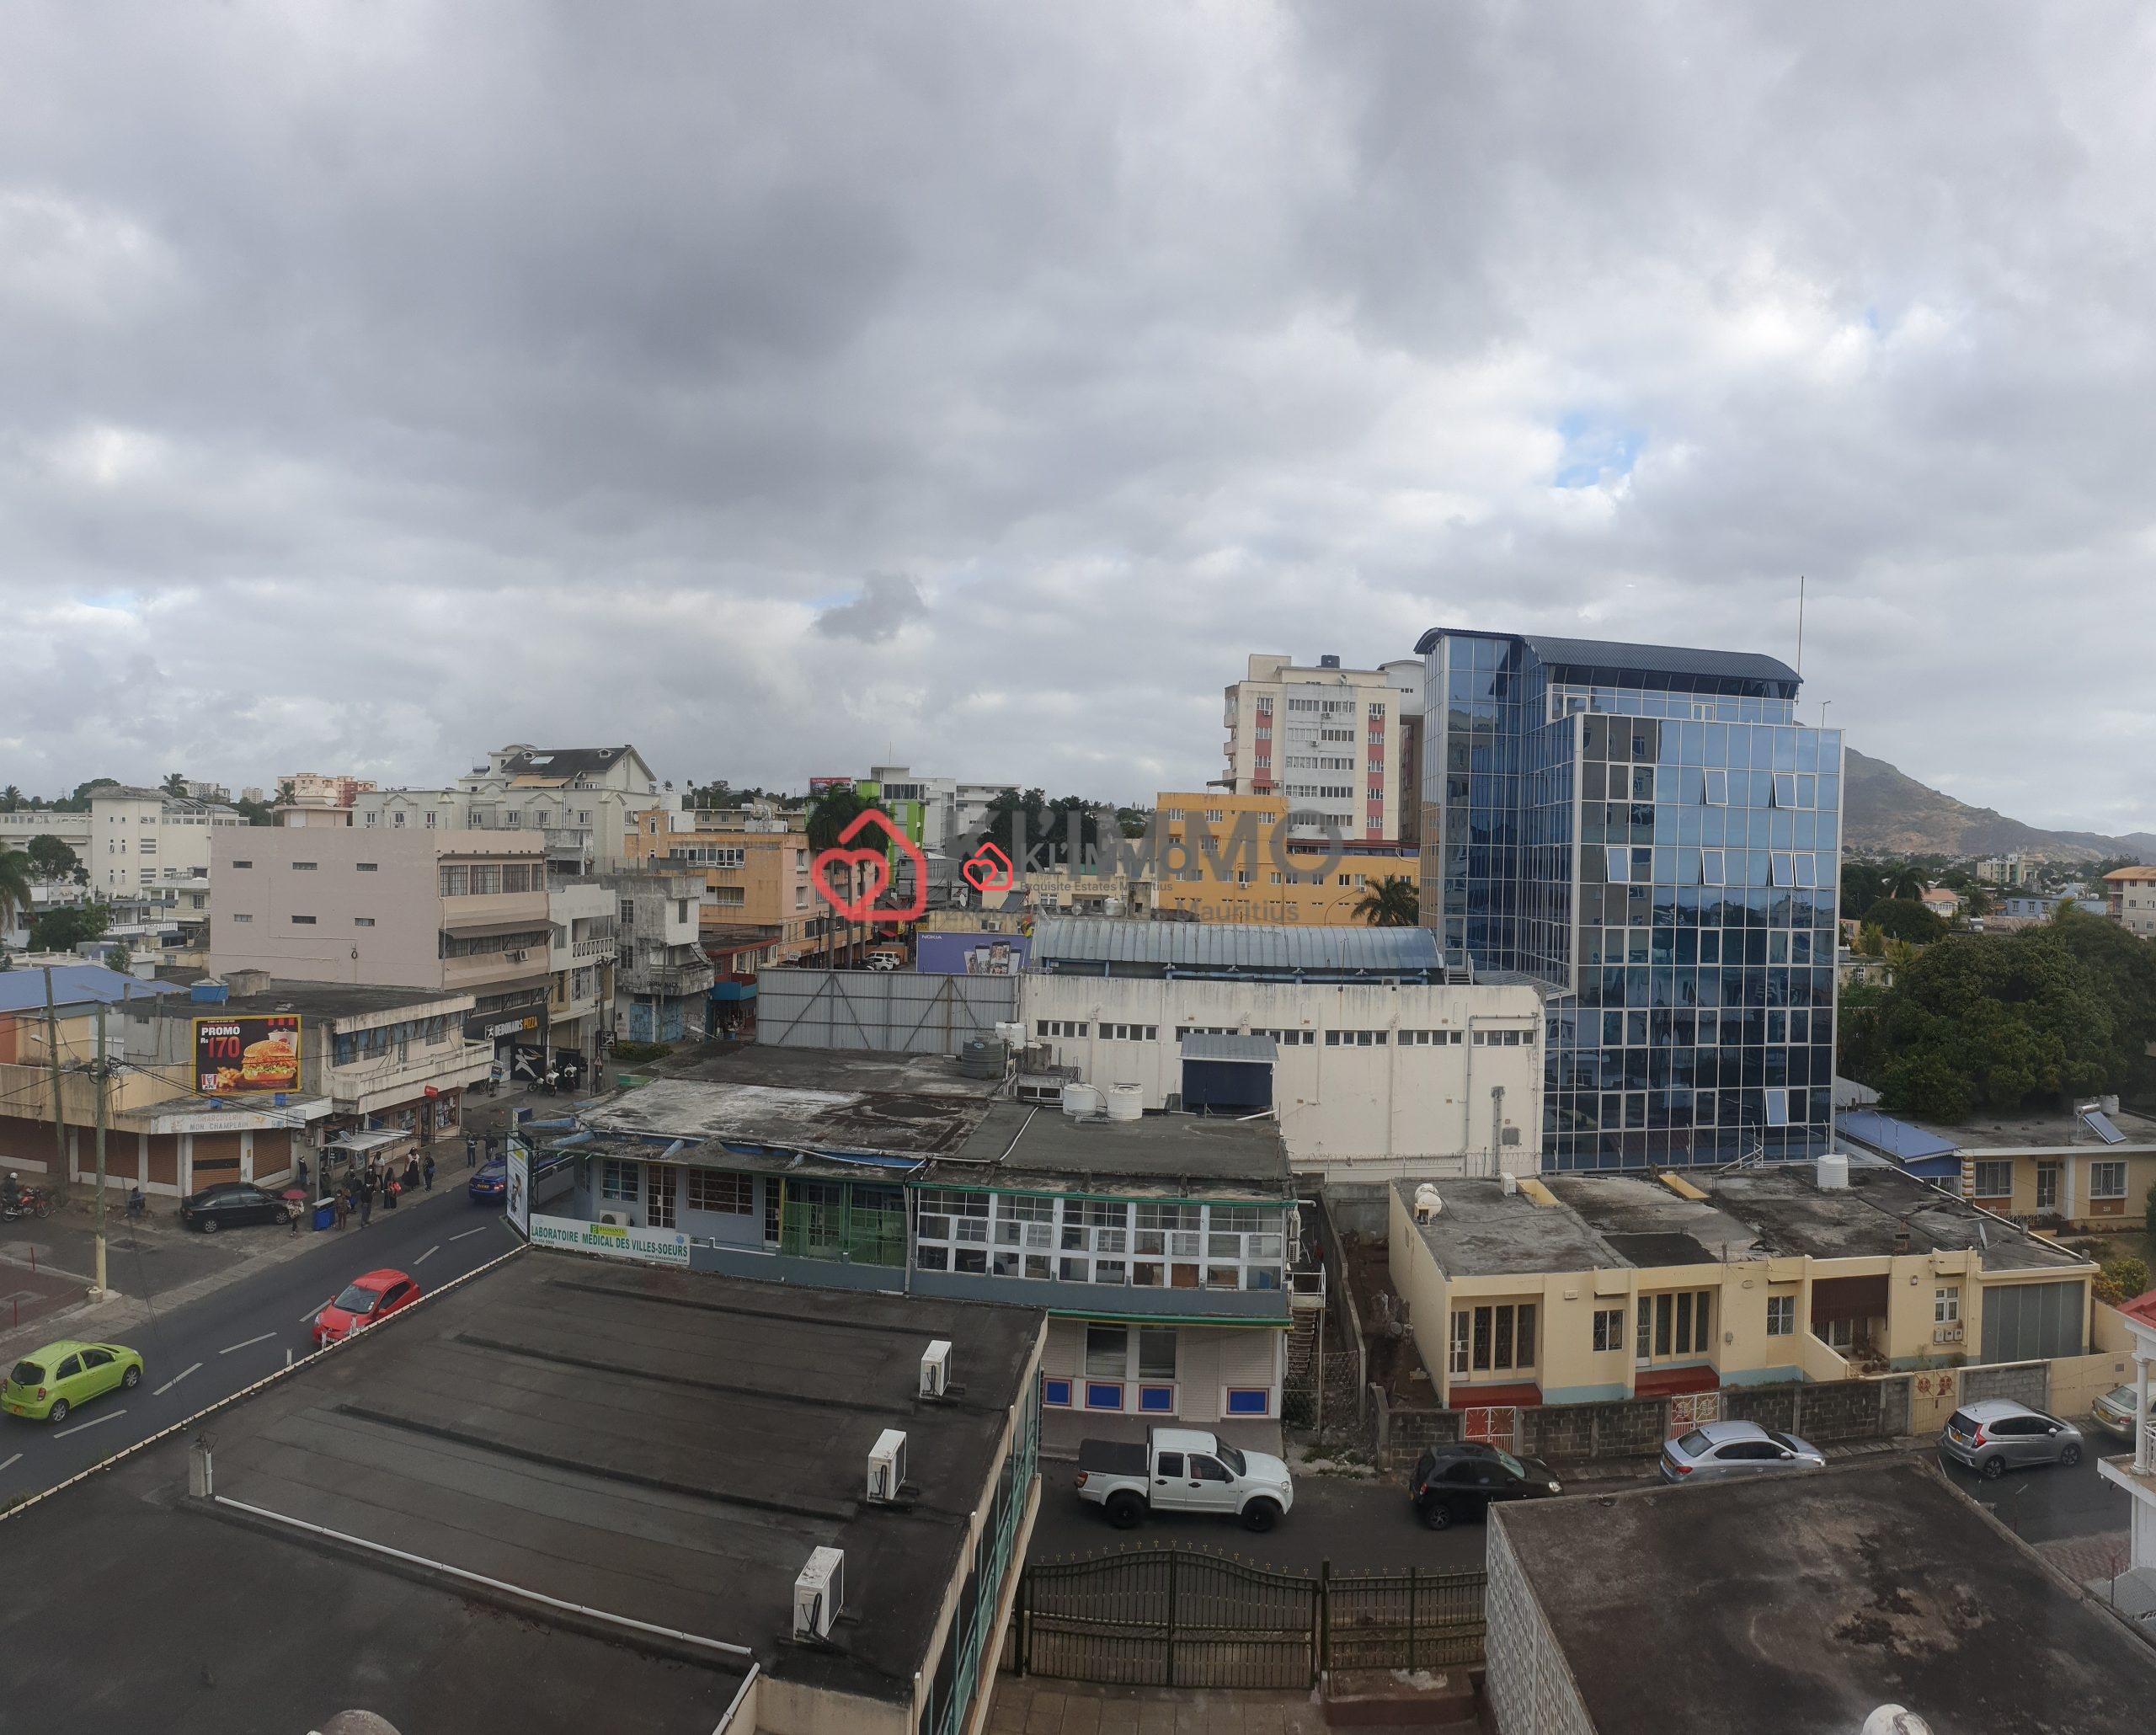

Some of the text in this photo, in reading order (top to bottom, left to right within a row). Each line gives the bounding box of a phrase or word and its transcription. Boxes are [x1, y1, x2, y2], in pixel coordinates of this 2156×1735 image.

[201, 1026, 241, 1036] PROMO
[494, 1016, 538, 1037] DEBONAIRS PIZZA
[208, 1036, 241, 1059] 170
[189, 1122, 248, 1131] MON CHAMPLAIN
[531, 1225, 688, 1257] LABORATOIRE MEDICAL DES VILLES-SOEURS
